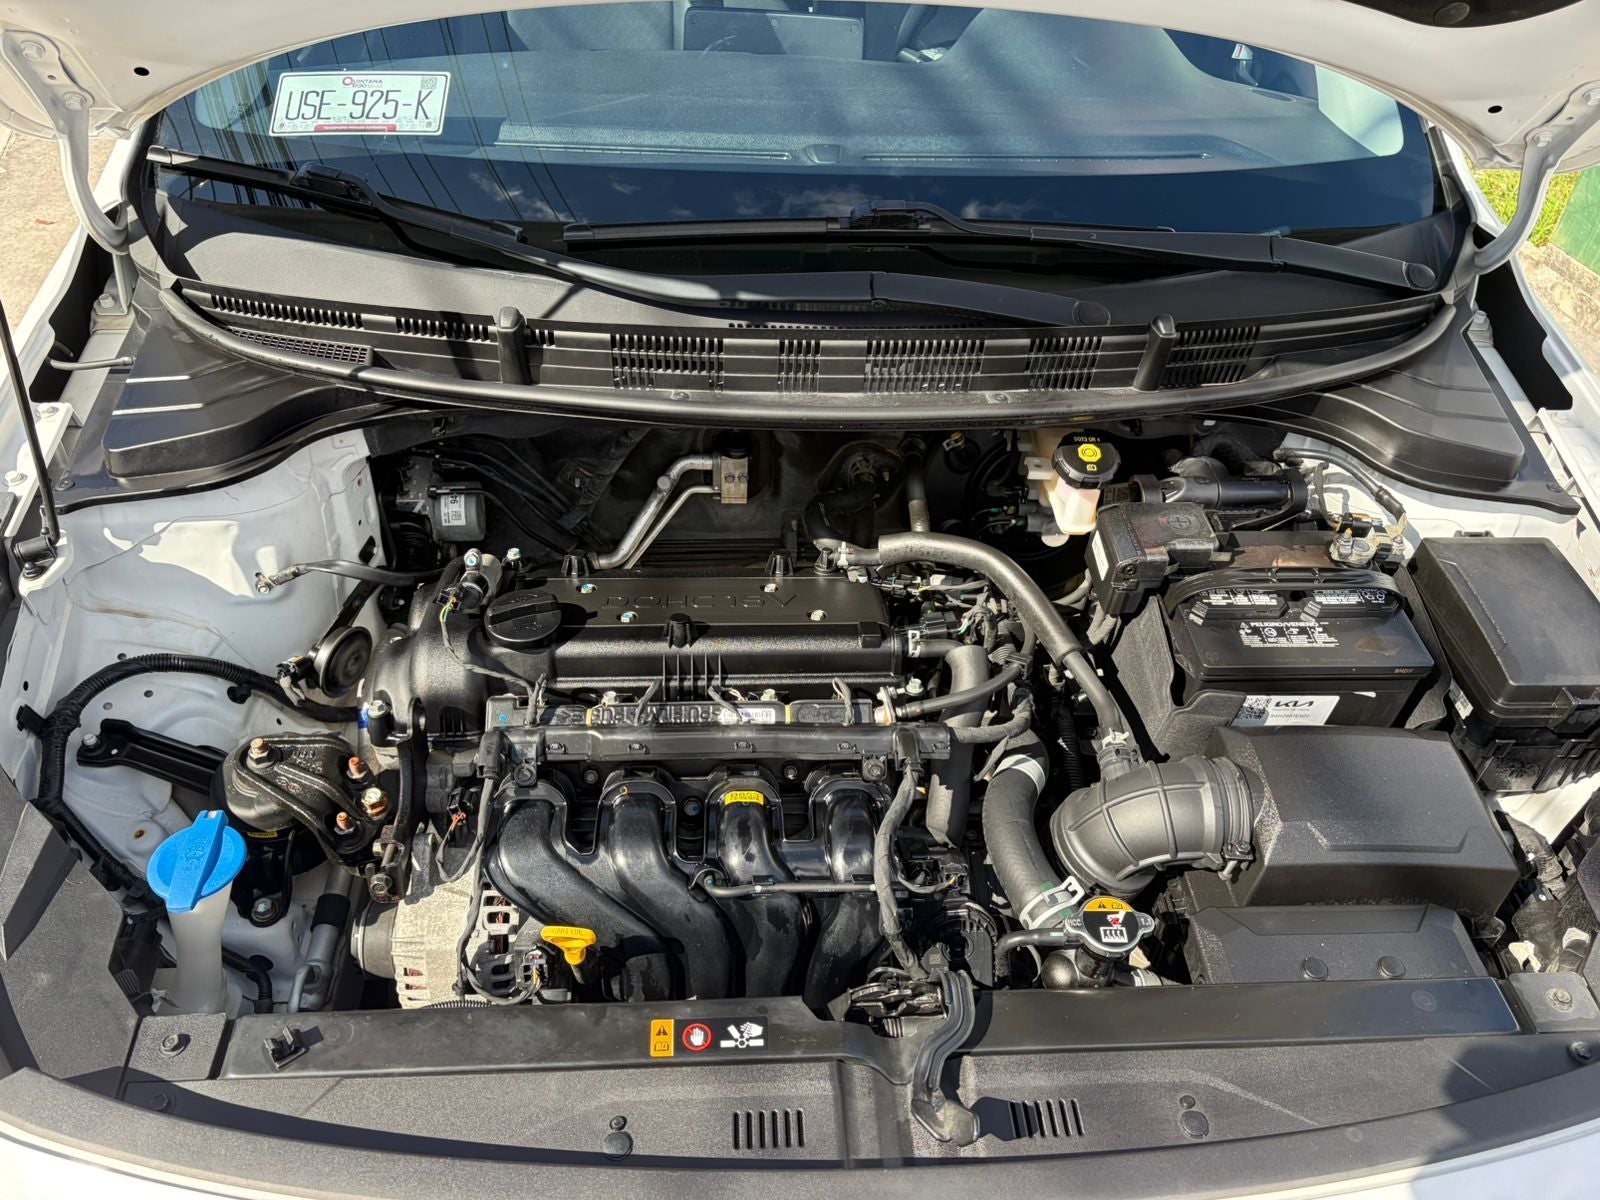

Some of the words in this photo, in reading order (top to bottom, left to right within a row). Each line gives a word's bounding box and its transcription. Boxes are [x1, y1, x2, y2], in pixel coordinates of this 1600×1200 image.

[285, 90, 433, 120] USE-925-K
[602, 594, 715, 609] DOHC
[724, 593, 798, 609] 16V
[1275, 700, 1314, 708] KIA
